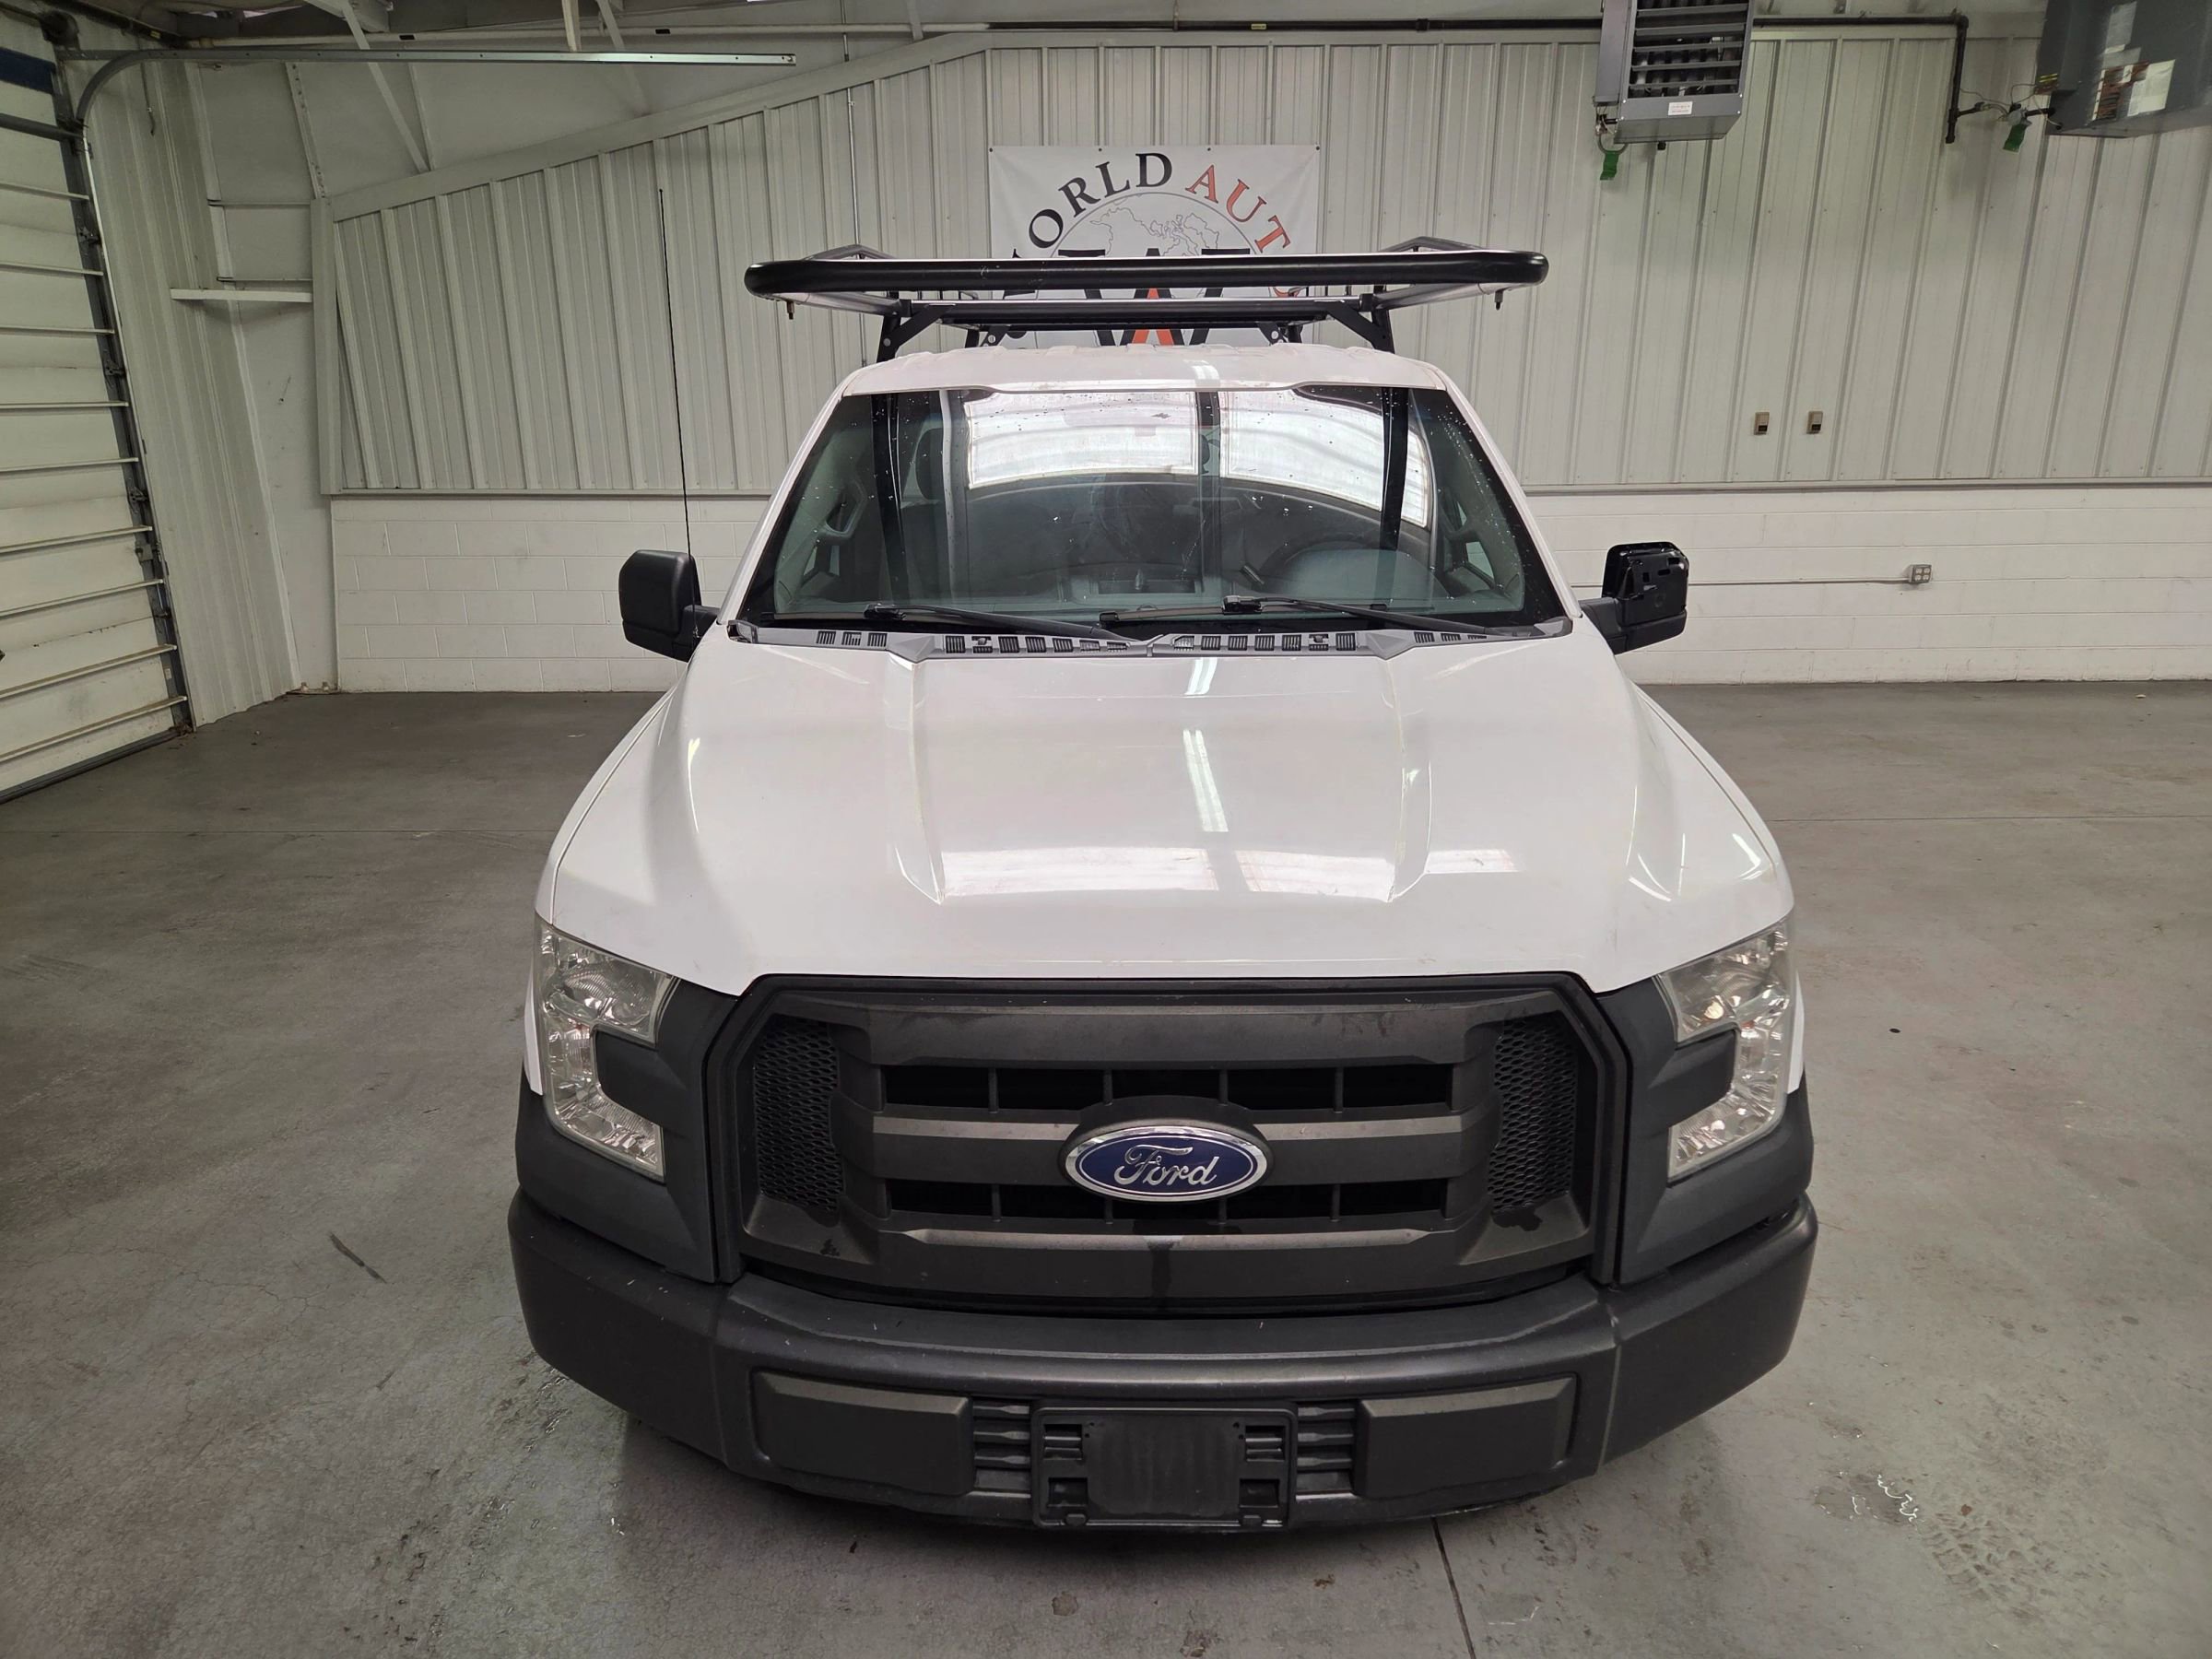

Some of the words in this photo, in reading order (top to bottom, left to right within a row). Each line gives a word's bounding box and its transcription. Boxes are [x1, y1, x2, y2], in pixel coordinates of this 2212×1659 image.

[1006, 152, 1172, 269] ORLD
[1185, 164, 1298, 288] AUT
[1113, 1144, 1220, 1186] Ford
